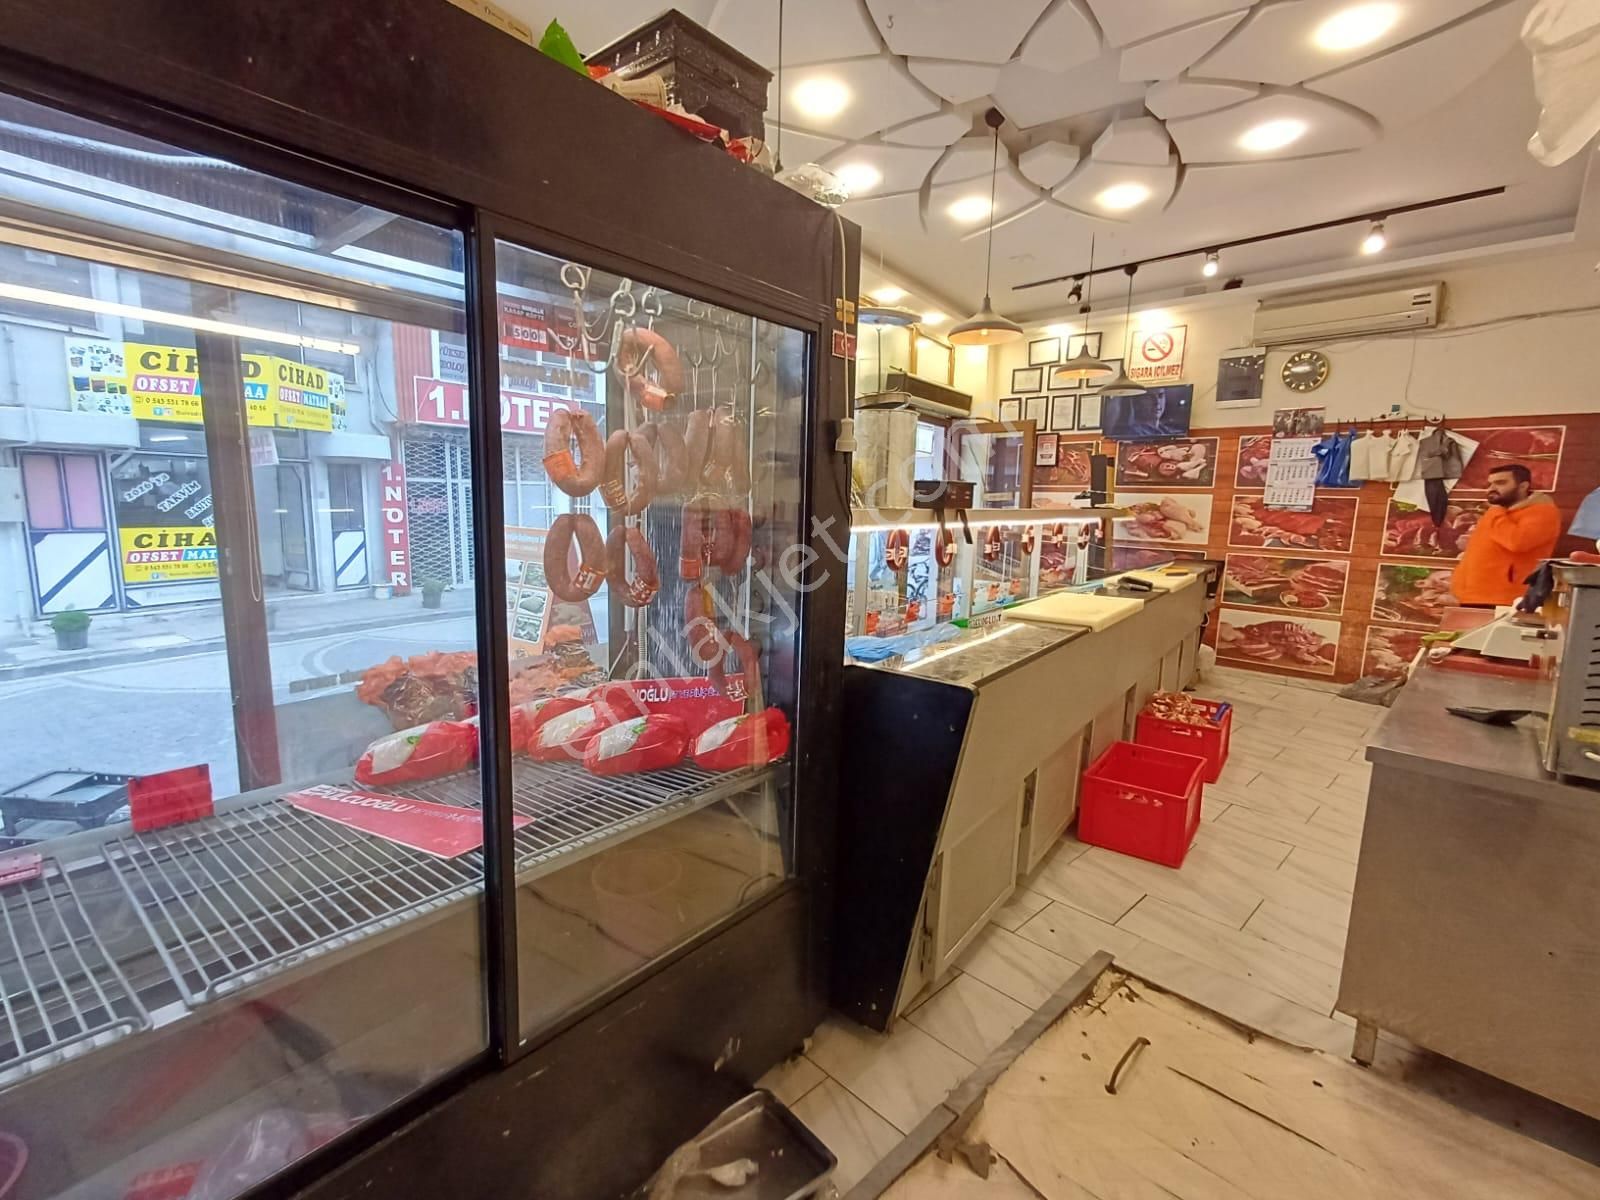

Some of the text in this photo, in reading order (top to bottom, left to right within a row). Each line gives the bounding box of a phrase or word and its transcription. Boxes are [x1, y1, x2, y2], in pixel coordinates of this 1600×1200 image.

[513, 327, 538, 341] 500
[136, 376, 190, 394] OFSET
[278, 363, 324, 390] CİHAD
[134, 529, 216, 549] CİHA
[130, 549, 217, 563] OFSET MAT
